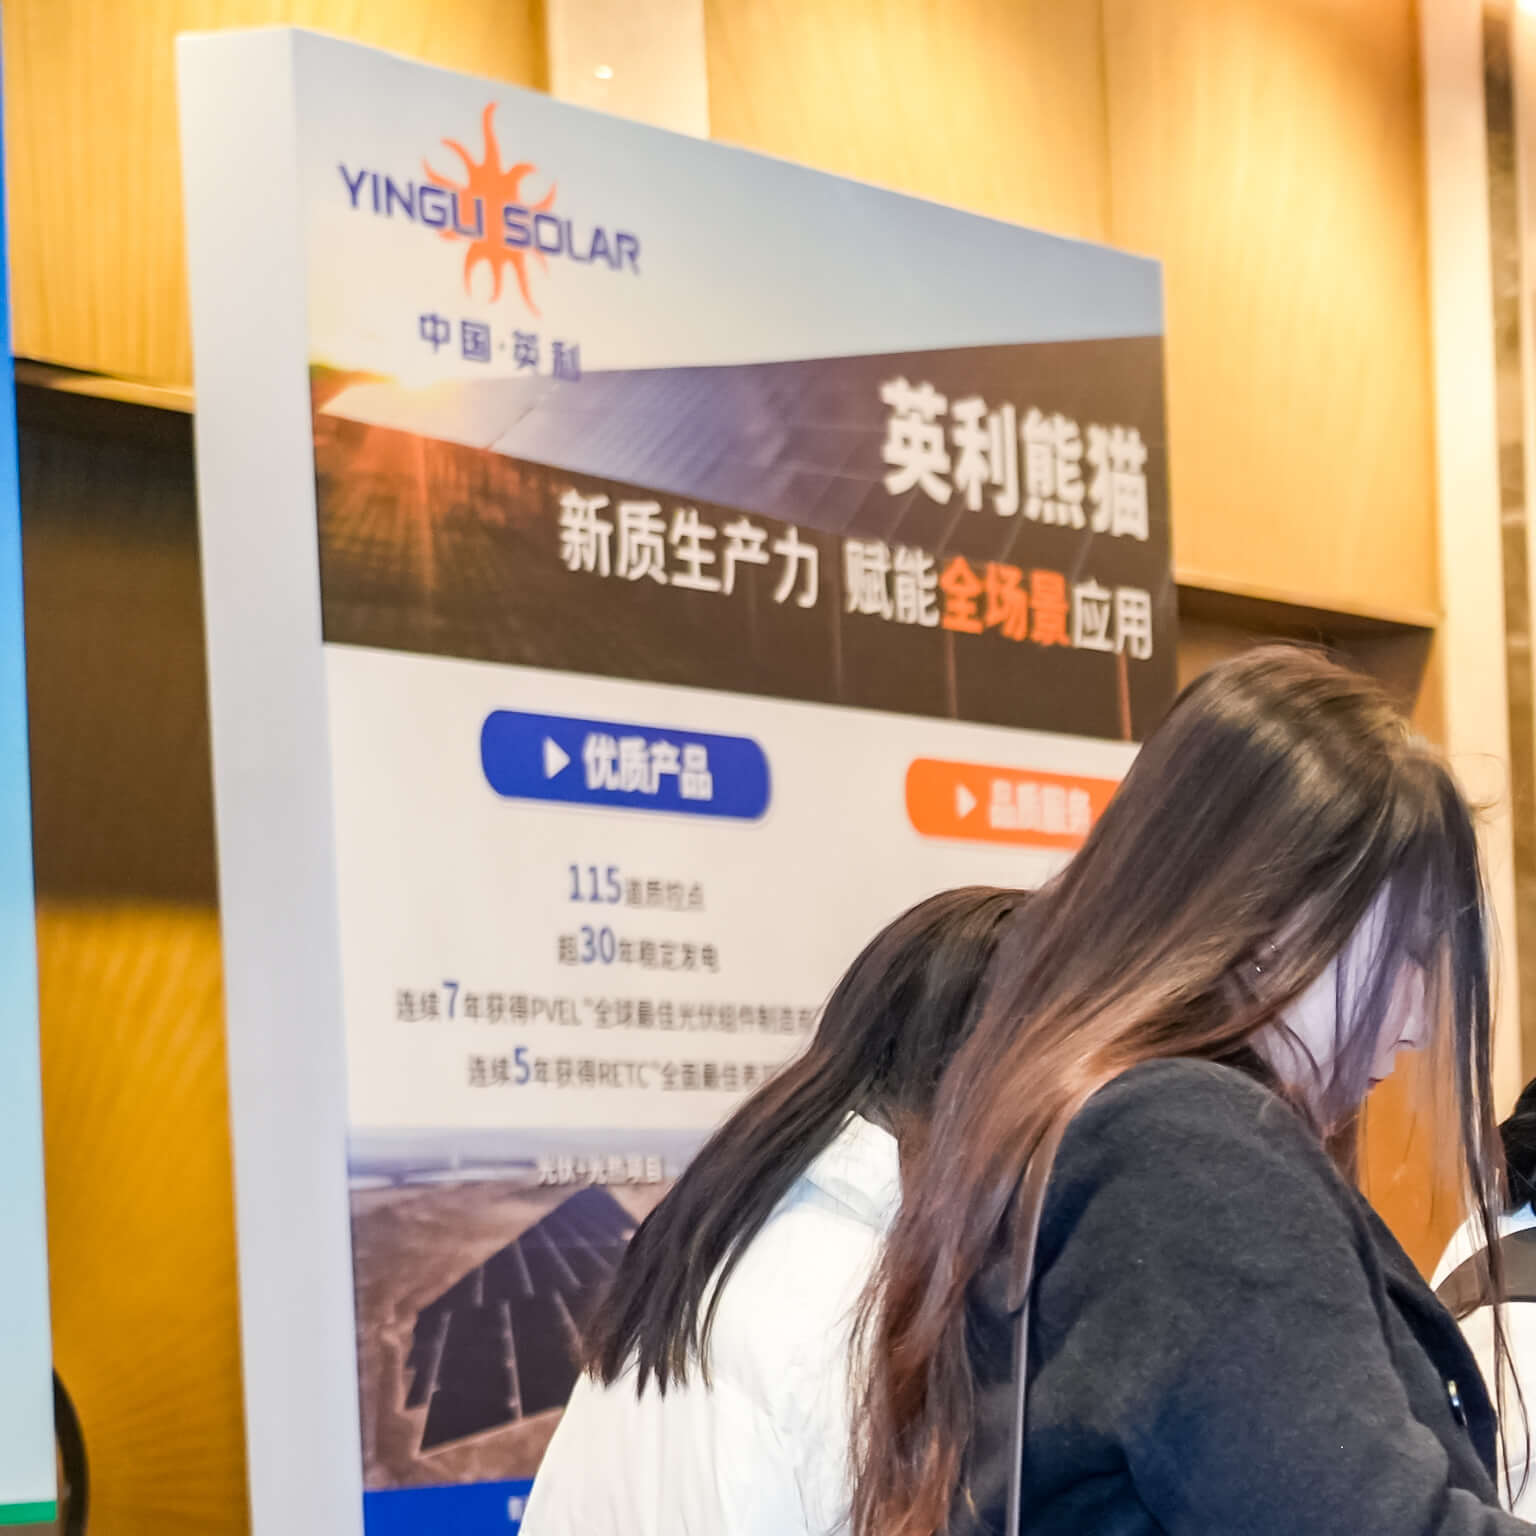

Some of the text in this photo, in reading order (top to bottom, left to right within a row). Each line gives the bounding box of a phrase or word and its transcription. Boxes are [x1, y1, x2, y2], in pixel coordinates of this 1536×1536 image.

[503, 204, 641, 275] SOLAR
[880, 377, 1149, 542] 英利熊猫
[557, 487, 1154, 661] 新质生产力 赋能全场景应用
[583, 732, 714, 801] 优质产品
